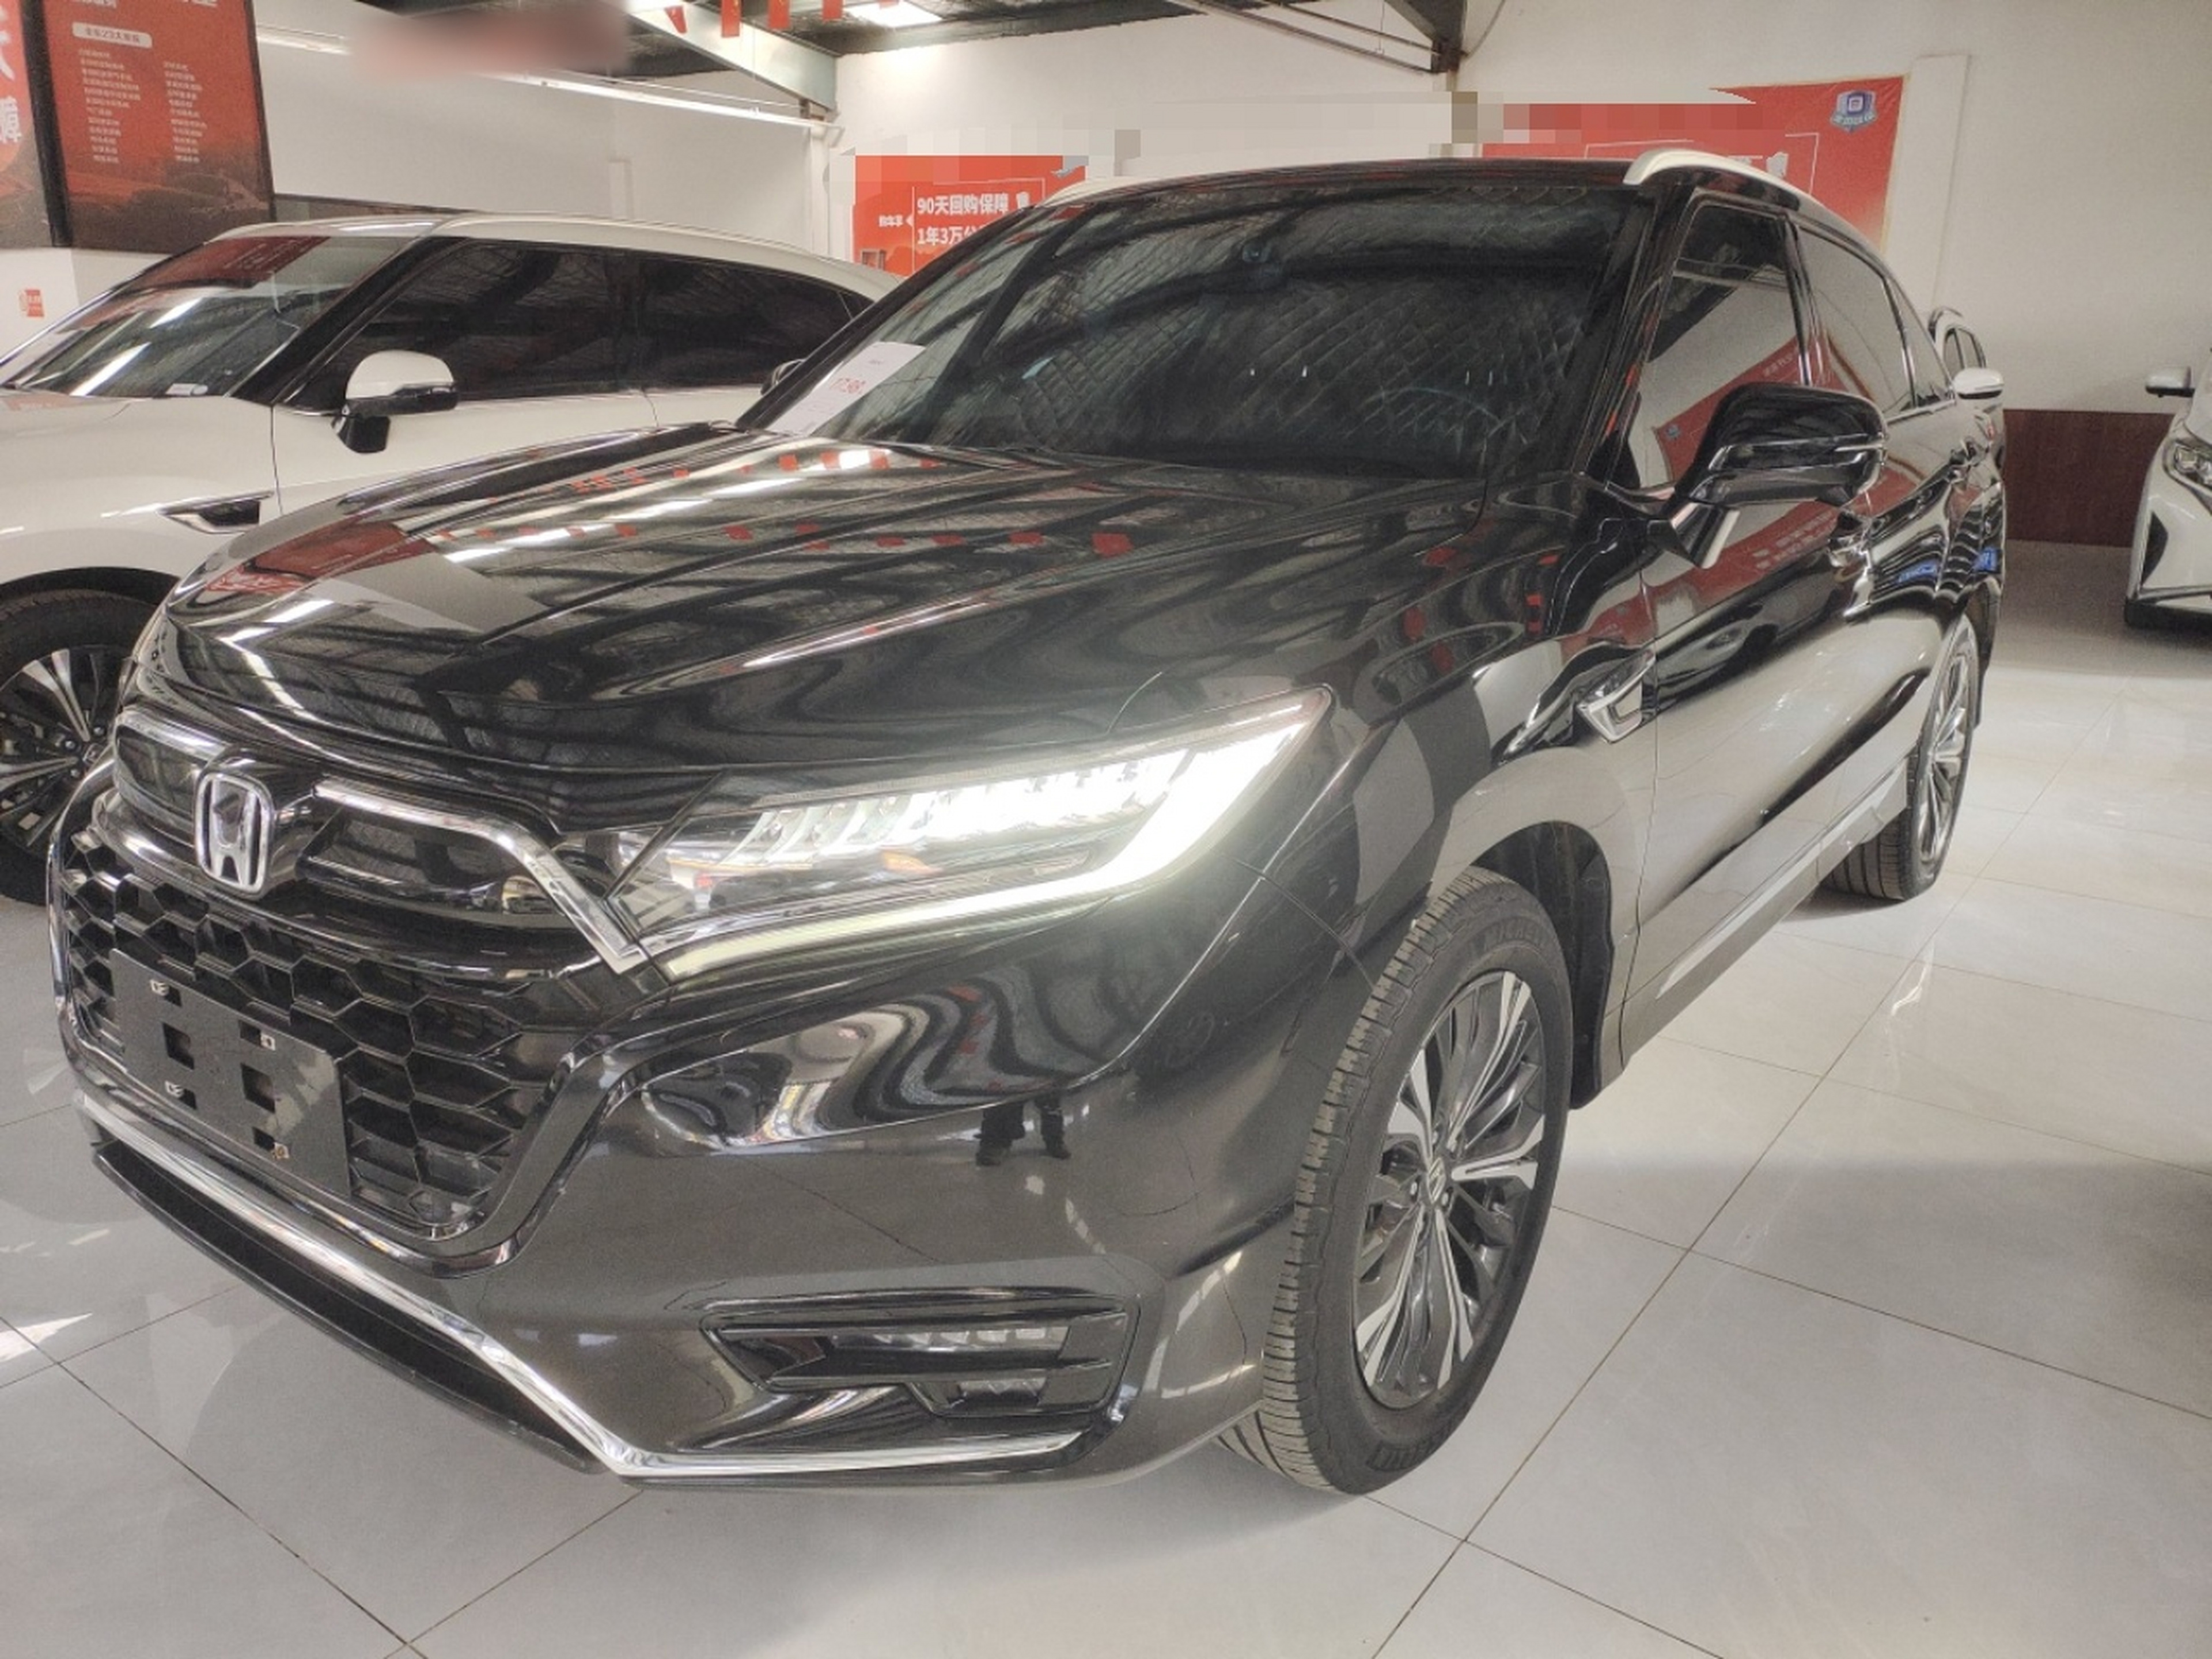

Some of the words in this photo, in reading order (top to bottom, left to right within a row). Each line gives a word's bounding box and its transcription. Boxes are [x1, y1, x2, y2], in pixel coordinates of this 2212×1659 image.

[917, 192, 1009, 215] 90天回购保障
